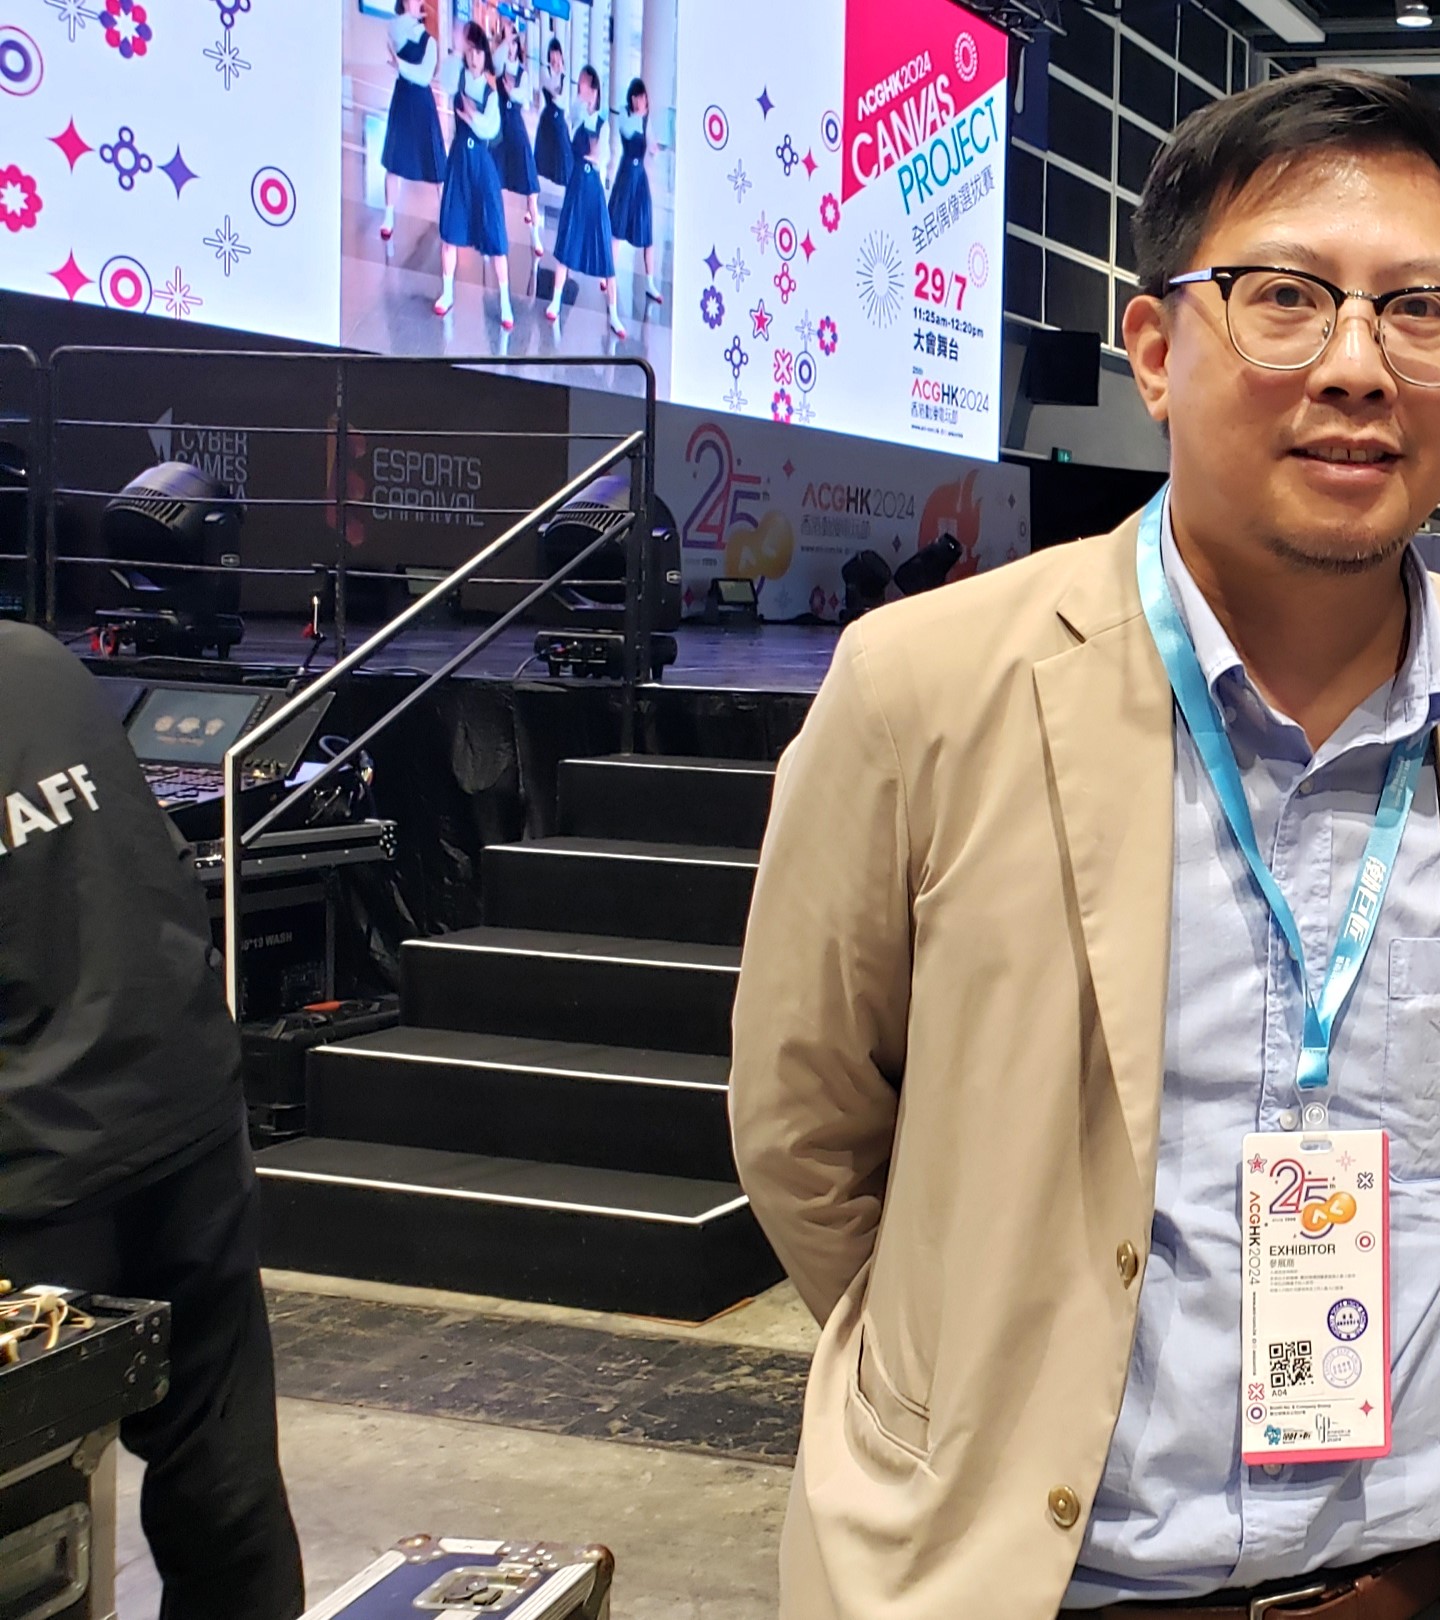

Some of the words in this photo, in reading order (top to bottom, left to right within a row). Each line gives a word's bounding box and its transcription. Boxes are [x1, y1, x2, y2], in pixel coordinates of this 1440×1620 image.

[851, 74, 956, 188] CANVAS
[898, 96, 999, 215] PROJECT
[912, 164, 996, 254] 全民偶像選拔賽
[914, 262, 967, 310] 29/7
[914, 306, 984, 338] 11:25am-12:20pm
[913, 327, 959, 361] 大會舞台
[911, 378, 989, 413] ACGHK2024
[180, 422, 248, 455] CYBER
[371, 447, 482, 491] ESPORTS
[371, 485, 485, 527] CARNIVAL
[801, 482, 916, 520] ACGHK2024
[0, 763, 100, 856] AFF
[265, 930, 293, 947] WASH
[1249, 1191, 1260, 1286] ACGHK2024
[1269, 1243, 1336, 1257] EXHIBITOR
[1271, 1389, 1288, 1397] A04
